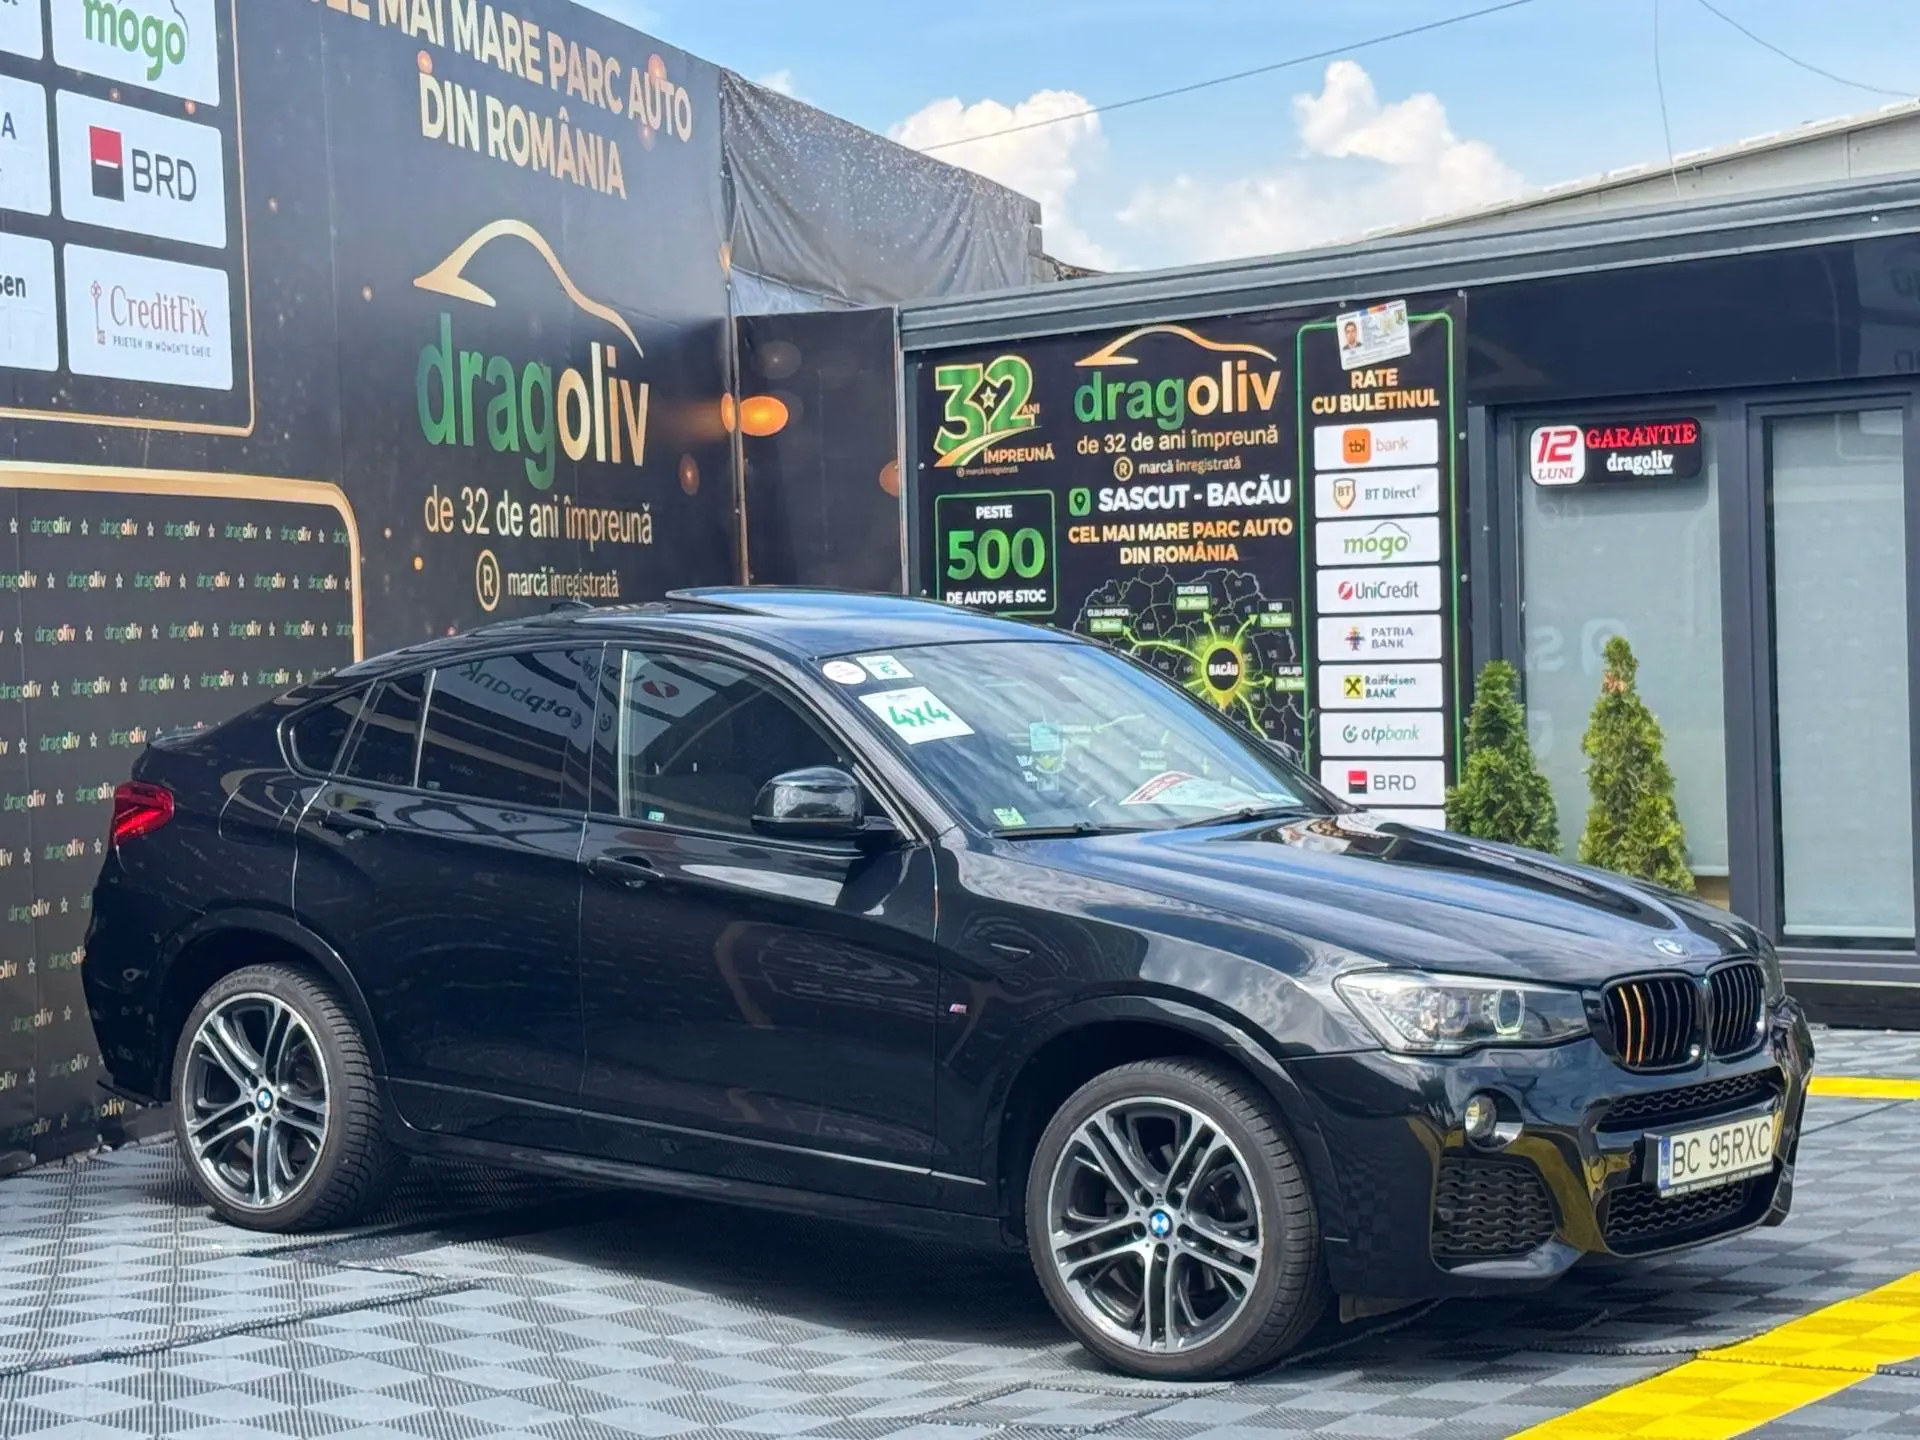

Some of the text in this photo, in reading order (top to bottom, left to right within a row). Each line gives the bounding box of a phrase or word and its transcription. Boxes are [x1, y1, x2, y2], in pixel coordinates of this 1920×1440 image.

[83, 0, 186, 82] mogo
[451, 0, 544, 85] MARE
[547, 30, 624, 115] PARC
[627, 67, 693, 143] AUTO
[418, 72, 628, 200] DIN ROMÂNIA
[132, 147, 198, 202] BRD
[110, 284, 209, 338] CreditFix
[1351, 368, 1399, 390] RATE
[415, 312, 650, 491] dragoliv
[933, 355, 1035, 457] 32
[1073, 359, 1282, 430] dragoliv
[1311, 388, 1441, 416] CU BULETINUL
[1021, 402, 1041, 415] ANI
[1077, 424, 1279, 456] de 32 de ani împreună
[1347, 436, 1409, 454] tbi bank
[1537, 430, 1578, 464] 12
[1585, 422, 1697, 449] GARANTIE
[1138, 459, 1174, 475] marcă
[1175, 456, 1241, 476] înregistrată
[1538, 467, 1574, 480] LUNI
[1606, 449, 1674, 475] dragoliv
[1097, 482, 1191, 512] SASCUT
[1206, 474, 1292, 508] BACĂU
[1364, 488, 1380, 501] BT
[424, 484, 653, 552] de 32 de ani împreună
[975, 504, 1014, 520] PESTE
[30, 516, 72, 538] dragoliv
[100, 518, 139, 539] dragoliv
[164, 520, 200, 541] dragoliv
[224, 522, 259, 542] dragoliv
[280, 525, 312, 545] dragoliv
[1067, 517, 1294, 544] CEL MAI MARE PARC AUTO
[946, 527, 1046, 581] 500
[1119, 542, 1240, 565] DIN ROMÂNIA
[1343, 536, 1409, 561] mogo
[0, 570, 339, 593] ragoliv dragoliv dragoliv dragoliv dragoliv dragoliv
[508, 566, 549, 597] marcă
[1355, 580, 1419, 600] UniCredit
[946, 588, 1047, 605] DE AUTO PE STOC
[35, 624, 77, 646] dragoliv
[104, 622, 143, 644] dragoliv
[168, 620, 205, 642] dragoliv
[229, 620, 262, 641] dragoliv
[284, 619, 315, 640] dragoliv
[1371, 627, 1414, 637] PATRIA
[1371, 638, 1405, 649] BANK
[1208, 661, 1239, 677] BACĂU
[1364, 674, 1416, 686] Raiffeisen
[0, 680, 42, 703] dragoliv
[71, 676, 111, 699] dragoliv
[138, 673, 175, 695] dragoliv
[200, 670, 235, 691] dragoliv
[257, 668, 290, 688] dragoliv
[1365, 688, 1397, 699] BANK
[40, 727, 147, 754] dragoliv dragoliv
[1361, 723, 1420, 745] otpbank
[1373, 774, 1417, 791] BRD
[4, 782, 116, 812] dragoliv dragoliv
[43, 838, 85, 862] dragoliv
[8, 898, 51, 923] dragoliv
[10, 1007, 53, 1033] dragoliv
[1672, 1121, 1771, 1179] BC 95RXC
